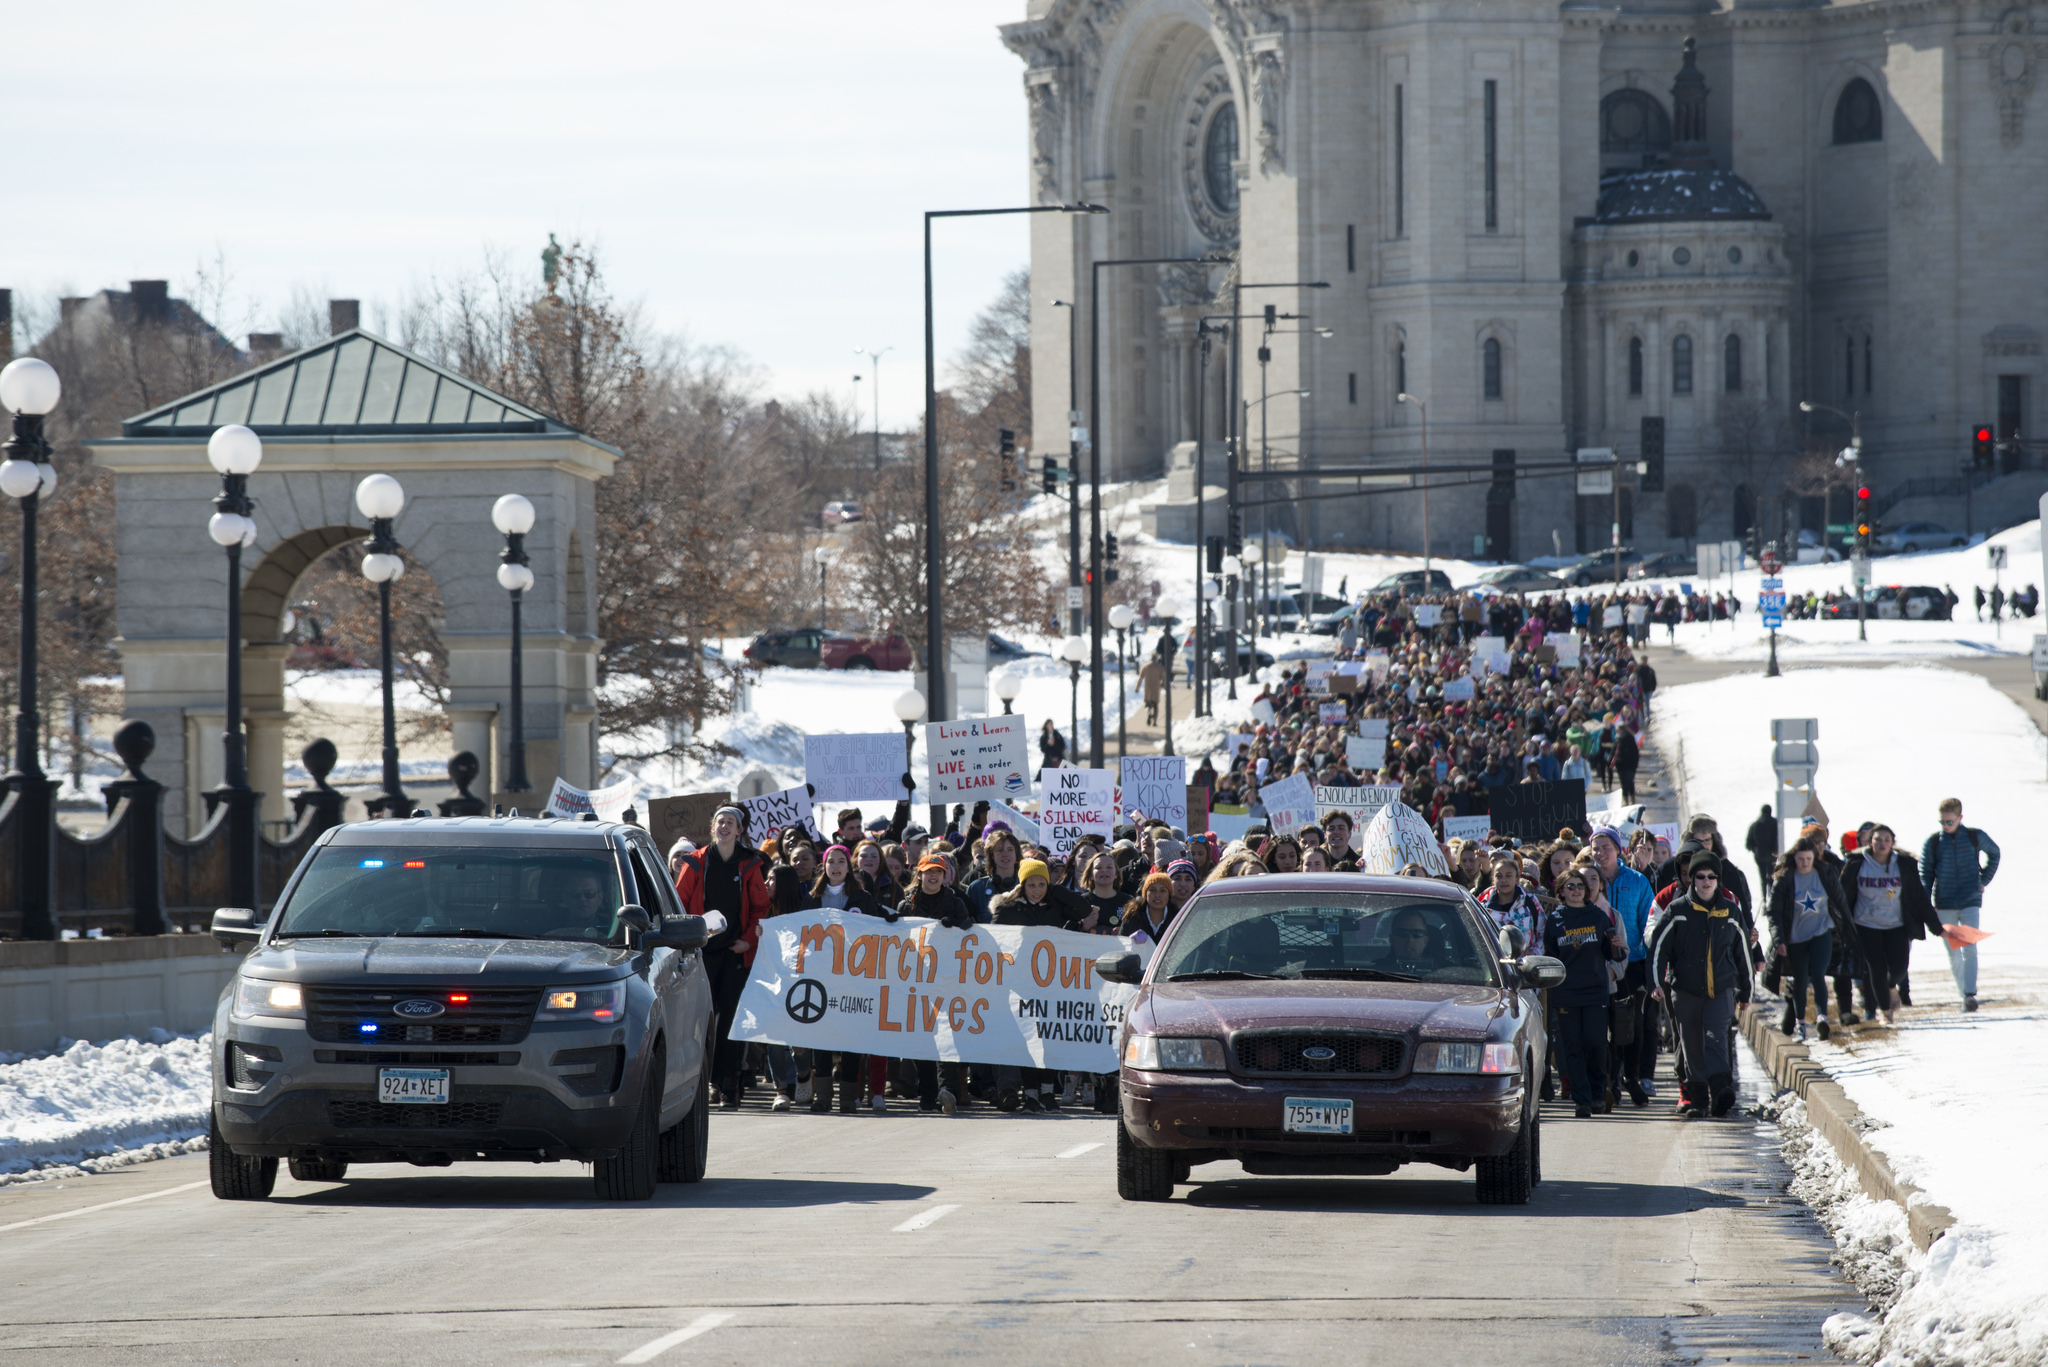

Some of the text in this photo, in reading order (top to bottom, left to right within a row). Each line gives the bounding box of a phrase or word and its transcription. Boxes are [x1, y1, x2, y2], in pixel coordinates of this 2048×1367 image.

[1761, 595, 1783, 608] 35E
[940, 726, 967, 739] Live
[971, 724, 979, 737] &
[807, 735, 905, 756] MY SIBLINGS
[950, 748, 966, 756] we
[979, 742, 1003, 754] must
[822, 754, 897, 775] WILL NOT
[937, 759, 1011, 775] LIVE in order
[1122, 758, 1185, 782] PROTECT
[817, 777, 901, 799] BE NEXT
[939, 782, 948, 791] to
[1061, 773, 1080, 789] NO
[744, 790, 789, 814] HOW
[1049, 792, 1087, 806] MORE
[1137, 783, 1173, 807] KIDS
[1316, 786, 1358, 804] ENOUGH
[1360, 787, 1368, 803] IS
[1505, 782, 1554, 807] STOP
[749, 802, 799, 833] MANY
[1044, 810, 1104, 825] SILENCE
[1273, 810, 1292, 830] NO
[1538, 803, 1579, 824] GUN
[1053, 826, 1083, 839] END
[1401, 832, 1428, 849] GUN
[1565, 925, 1596, 937] SPARTANS
[955, 933, 1015, 985] for
[1031, 939, 1096, 989] Our
[404, 1001, 433, 1013] Ford
[878, 985, 989, 1034] Lives
[1018, 999, 1048, 1018] MN
[1056, 1000, 1095, 1021] HIGH
[1036, 1021, 1117, 1045] WALKOUT
[384, 1077, 446, 1095] 924 XET
[1289, 1106, 1349, 1124] 755 WYP
